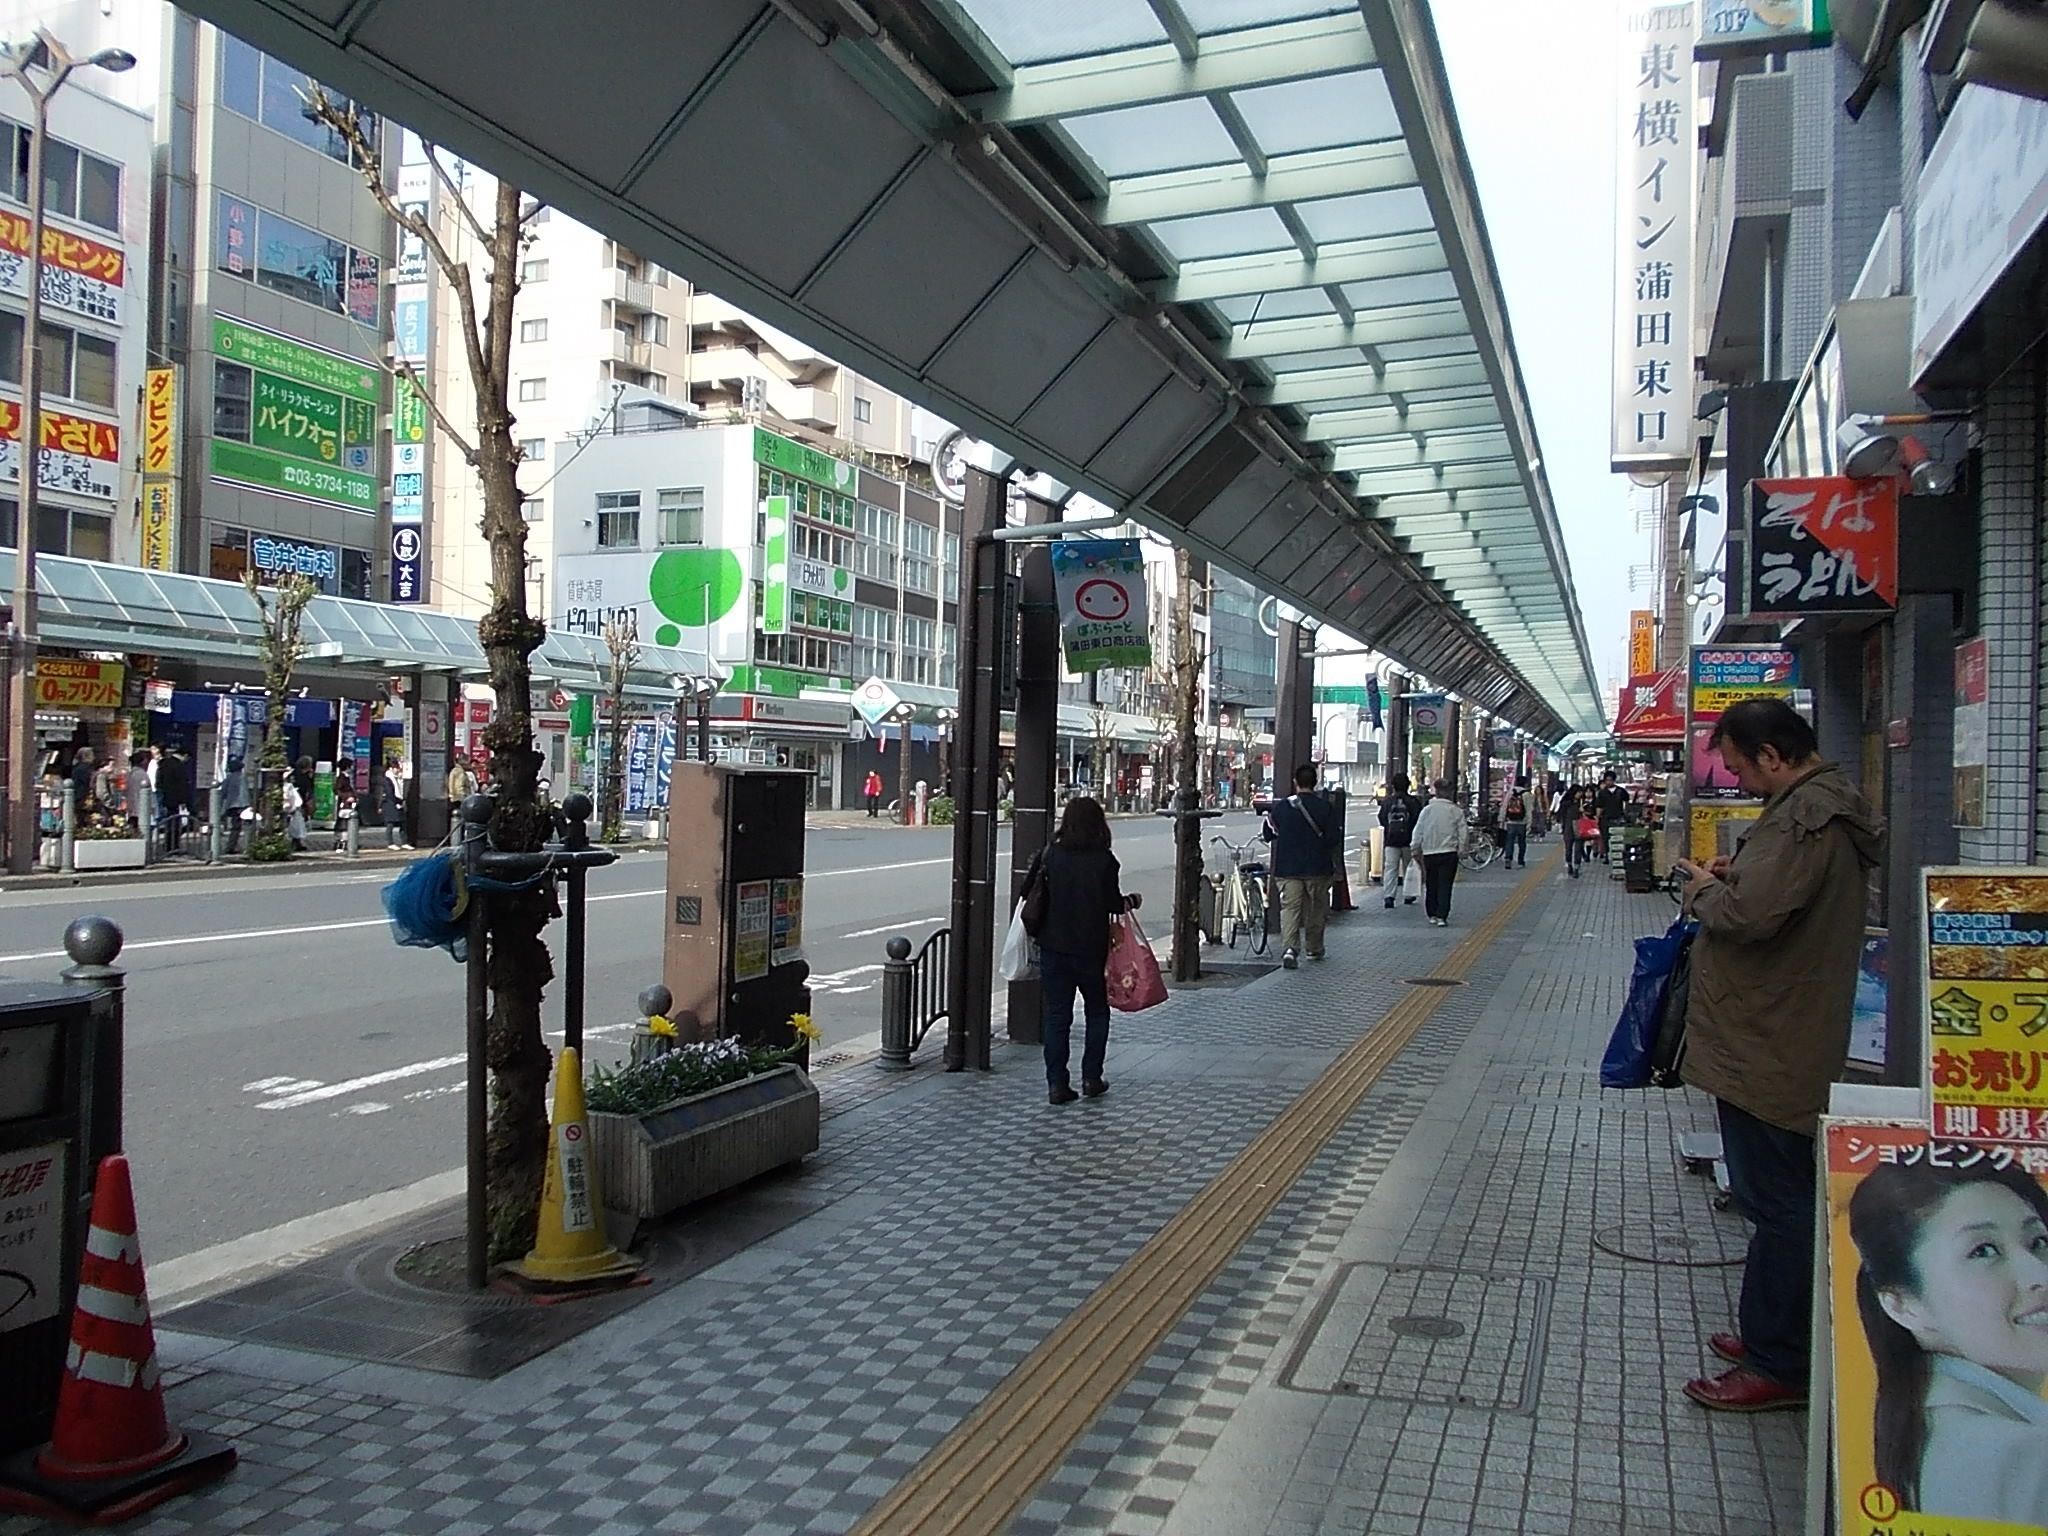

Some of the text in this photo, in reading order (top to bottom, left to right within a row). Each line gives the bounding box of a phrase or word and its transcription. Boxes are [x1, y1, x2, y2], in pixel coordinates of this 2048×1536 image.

[1628, 7, 1692, 33] HOTEL
[1714, 8, 1750, 33] 1F
[1632, 43, 1682, 443] 東横イン蒲田東口
[149, 374, 170, 468] ダビング
[258, 405, 337, 444] バイフォー
[297, 467, 370, 500] 03-3734-1188
[396, 475, 422, 495] 歯科
[1760, 480, 1888, 539] そば
[254, 538, 336, 579] 菅井歯科
[1759, 548, 1880, 604] うどん
[399, 564, 413, 598] 大吉
[1932, 1047, 2048, 1092] お売り
[567, 1156, 588, 1227] 駐輪禁止
